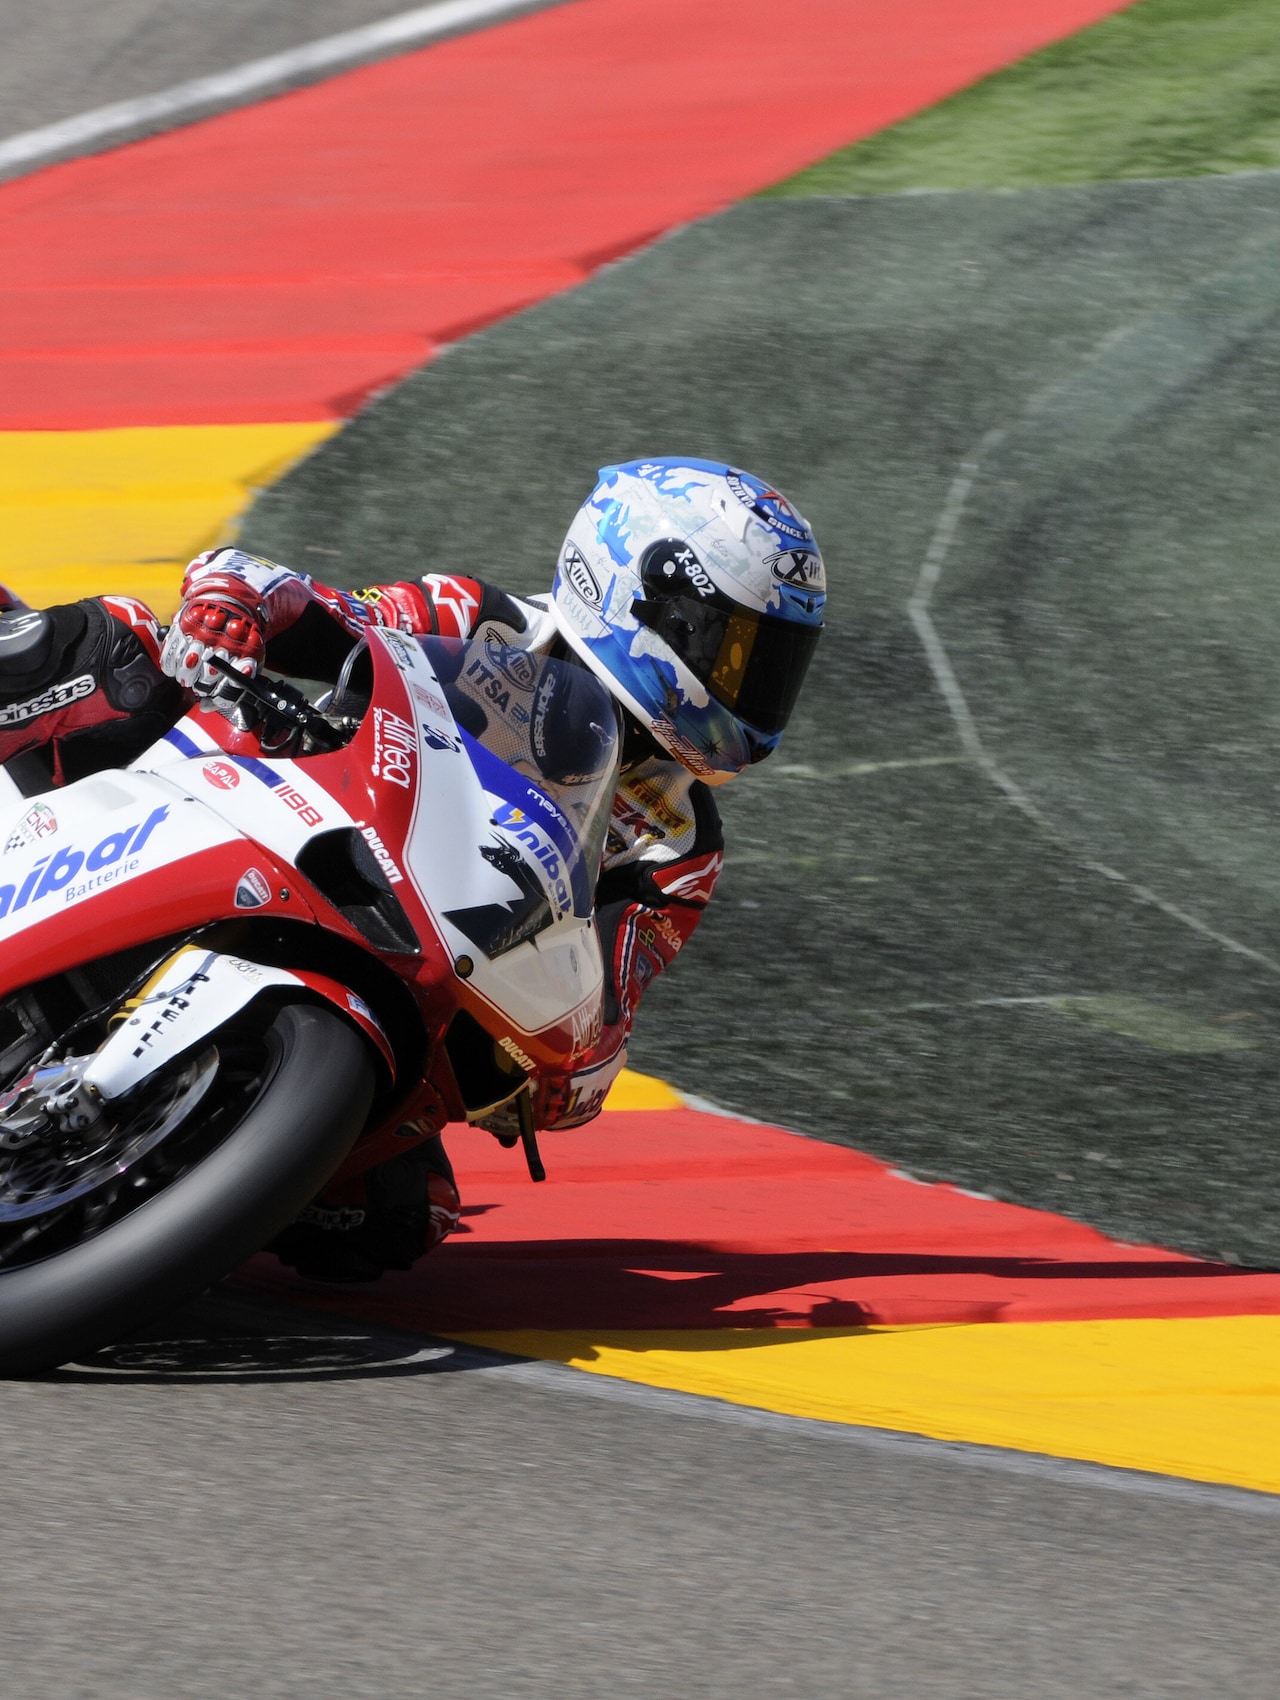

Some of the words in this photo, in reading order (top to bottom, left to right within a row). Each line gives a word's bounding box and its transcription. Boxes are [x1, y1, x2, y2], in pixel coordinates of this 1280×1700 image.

[565, 551, 596, 599] X-lite
[674, 548, 716, 597] X-802
[466, 660, 511, 713] ITSA
[382, 708, 417, 790] Althea
[203, 761, 238, 790] SAPAL
[274, 784, 324, 828] 1198
[362, 826, 403, 884] DUCATI
[65, 858, 140, 903] Batterie
[132, 973, 210, 1058] PIRELLI
[498, 1036, 536, 1071] DUCATI
